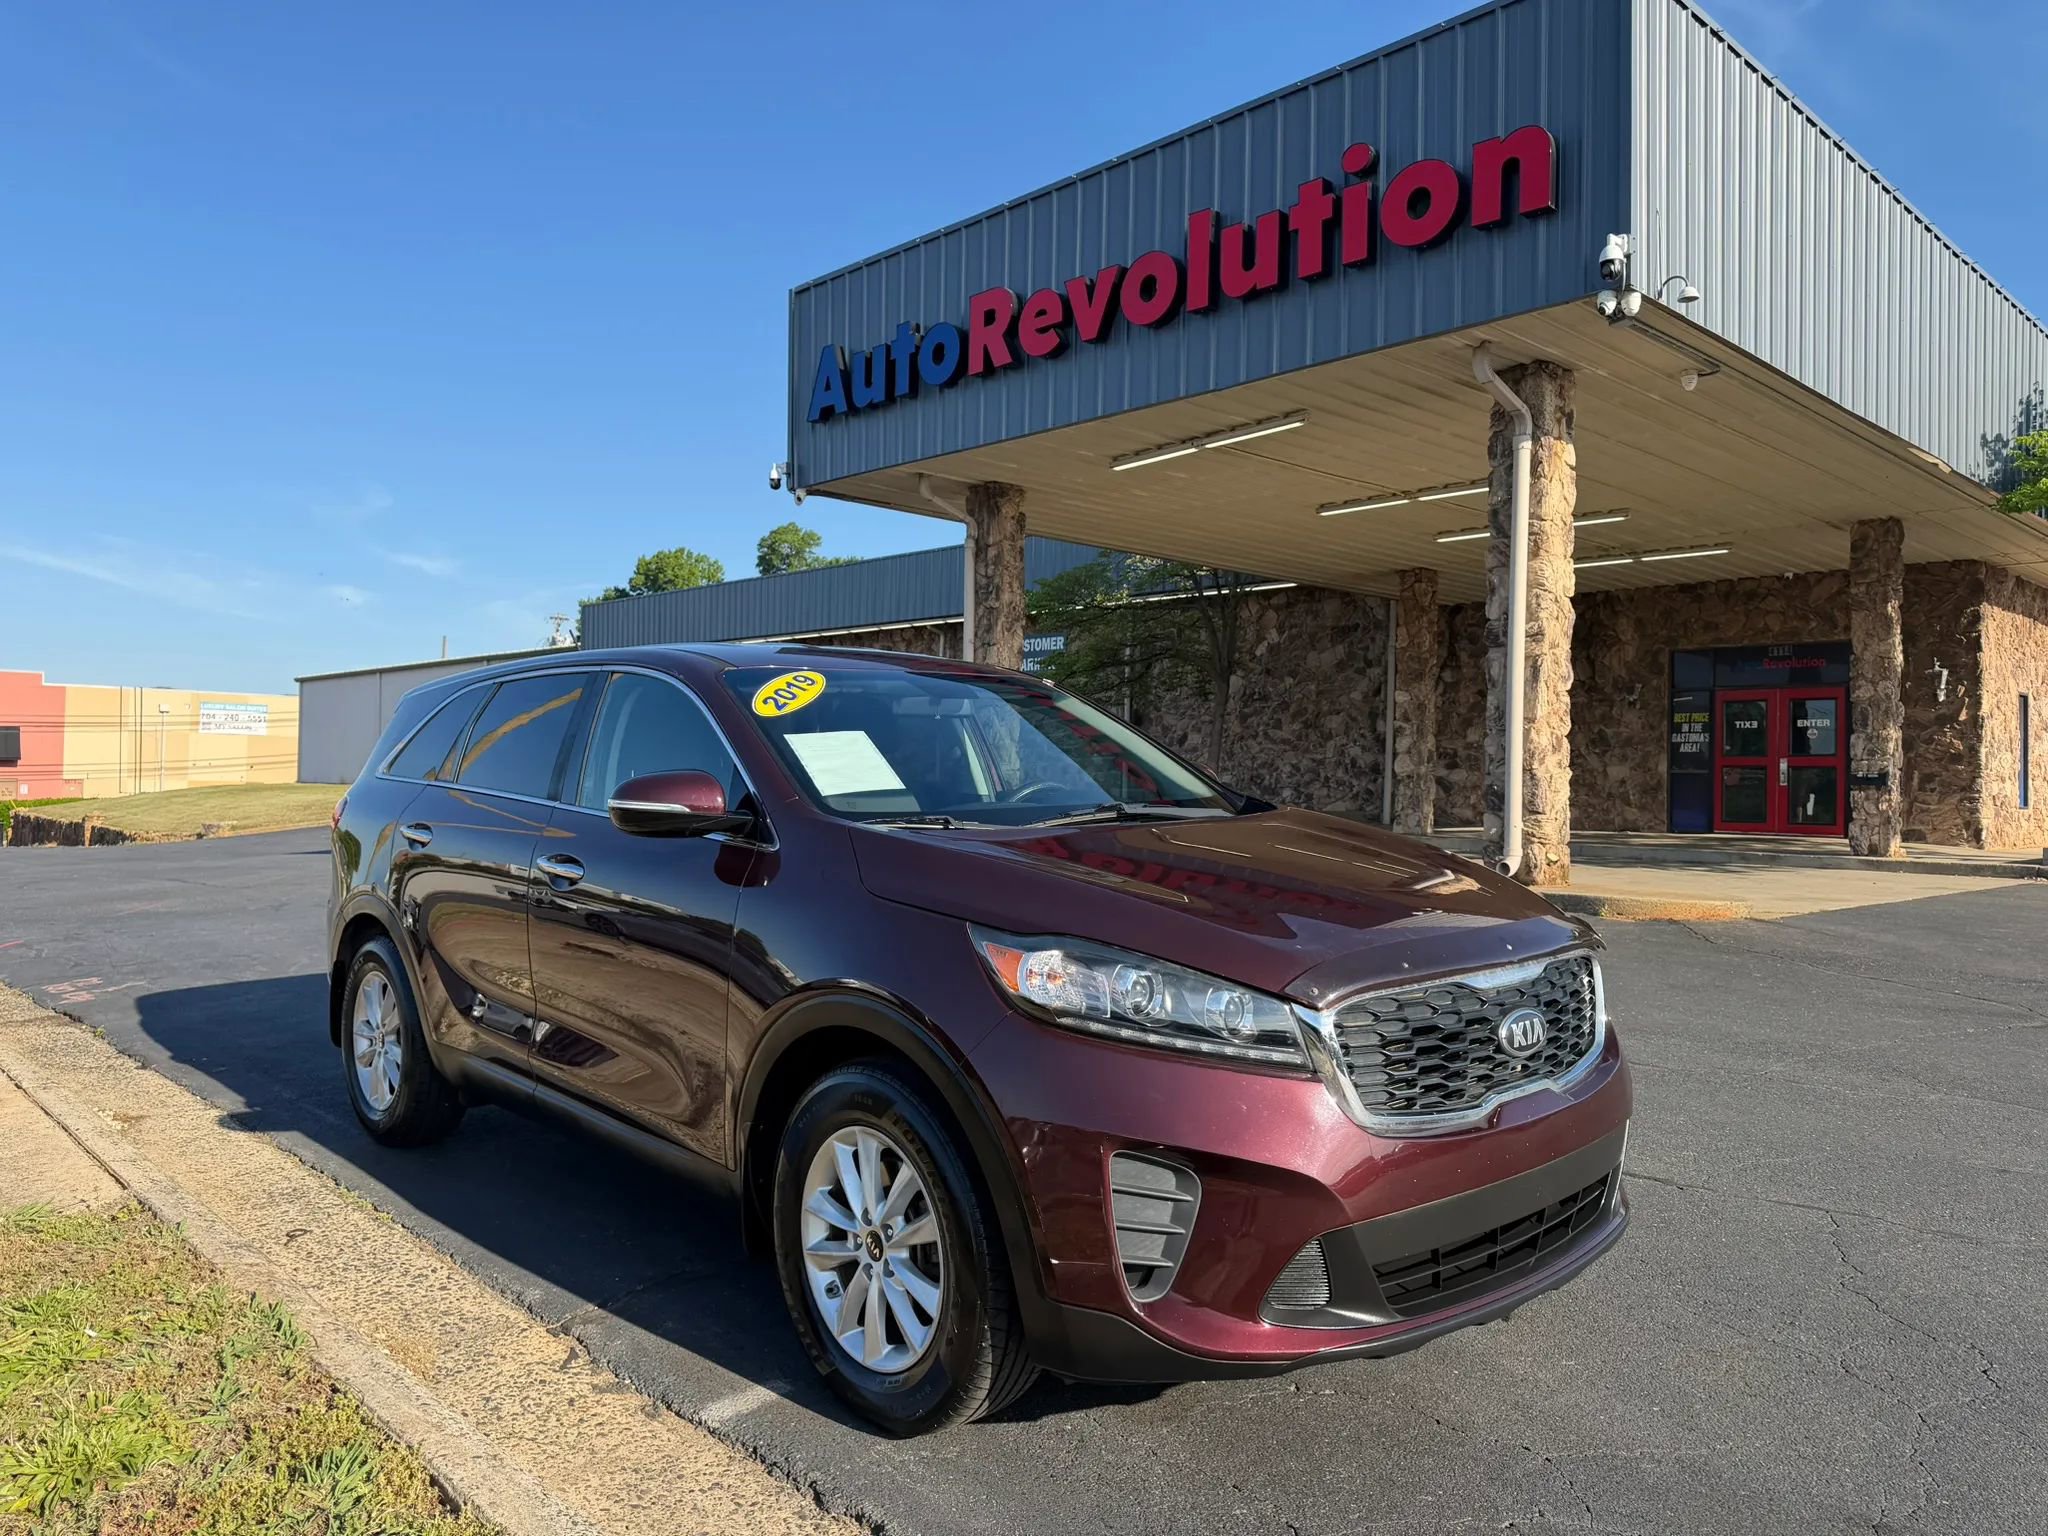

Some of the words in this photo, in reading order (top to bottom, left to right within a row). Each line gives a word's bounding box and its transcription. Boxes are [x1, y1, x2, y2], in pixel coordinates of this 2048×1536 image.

[762, 674, 816, 712] 2019
[1673, 713, 1690, 722] BEST
[1691, 712, 1709, 722] PRICE
[1690, 723, 1703, 732] THE
[1796, 719, 1831, 728] ENTER
[1679, 742, 1700, 752] AREA!
[1511, 1018, 1543, 1048] KIA
